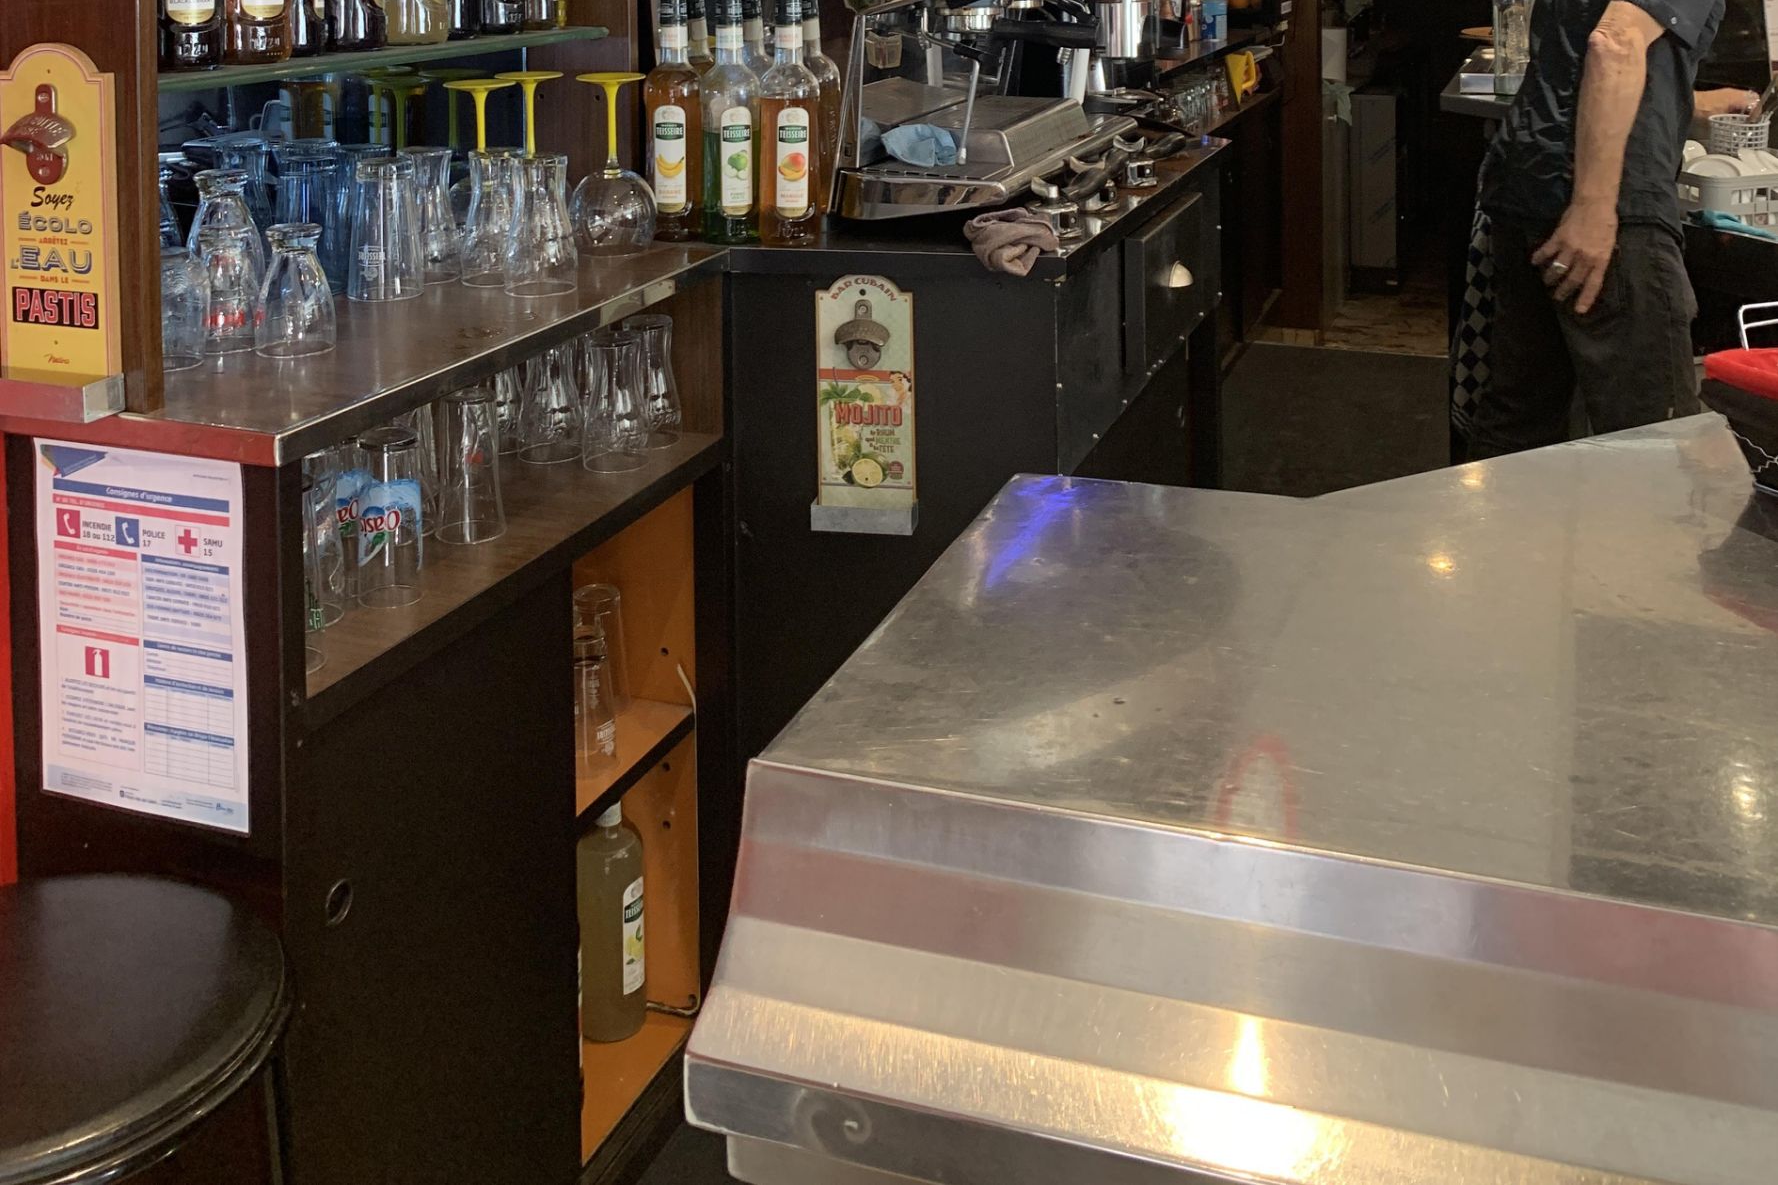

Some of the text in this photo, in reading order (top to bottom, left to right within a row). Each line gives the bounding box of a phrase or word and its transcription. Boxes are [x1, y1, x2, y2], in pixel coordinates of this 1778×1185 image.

[656, 126, 683, 136] TEISSEIRE
[723, 128, 750, 139] TEISSEIRE
[779, 129, 807, 139] TEISSEIRE
[31, 186, 74, 211] Soyez
[18, 211, 92, 235] ÉCOLO
[39, 236, 68, 245] ARRÊTEZ
[10, 245, 92, 274] L'EAU
[831, 277, 897, 302] BAR CUBAIN
[15, 289, 96, 327] PASTIS
[834, 404, 903, 426] MOJITO
[106, 487, 173, 503] Consignes d'urgence
[82, 520, 112, 531] INCENDIE
[82, 531, 91, 539] 18
[103, 533, 115, 542] 112
[142, 529, 166, 539] POLICE
[142, 539, 151, 547] 17
[203, 538, 223, 548] SAMU
